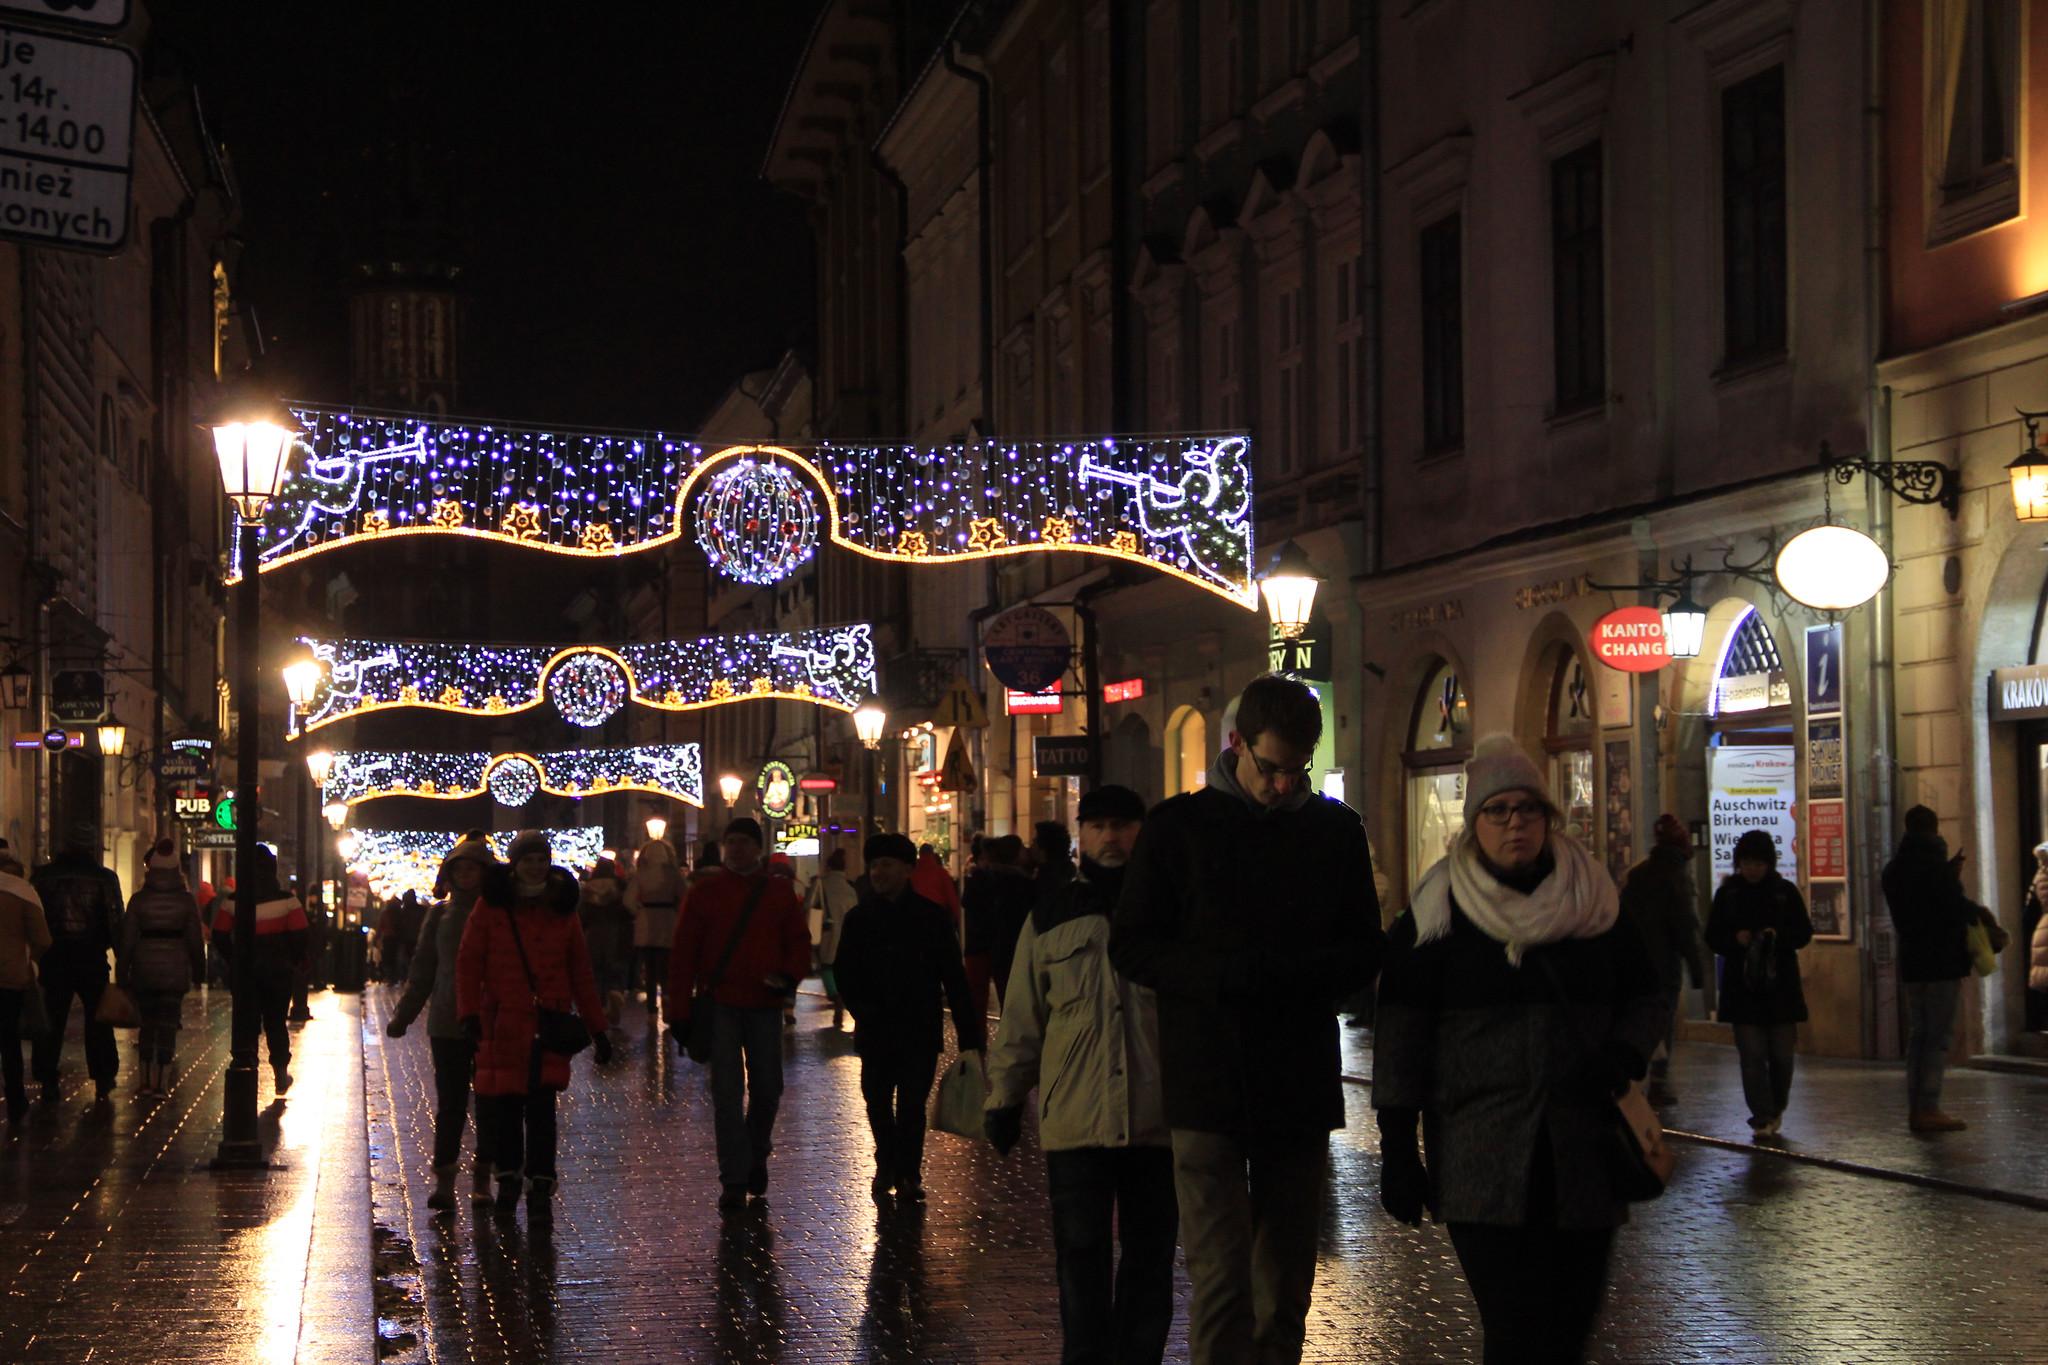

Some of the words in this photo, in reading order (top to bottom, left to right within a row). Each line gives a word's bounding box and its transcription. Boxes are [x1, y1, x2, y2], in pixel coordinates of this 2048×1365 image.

[0, 203, 111, 238] onych
[1602, 623, 1665, 638] KANTO
[175, 798, 211, 813] PUB
[1714, 798, 1787, 811] Auschwitz
[1714, 813, 1778, 826] Birkenau
